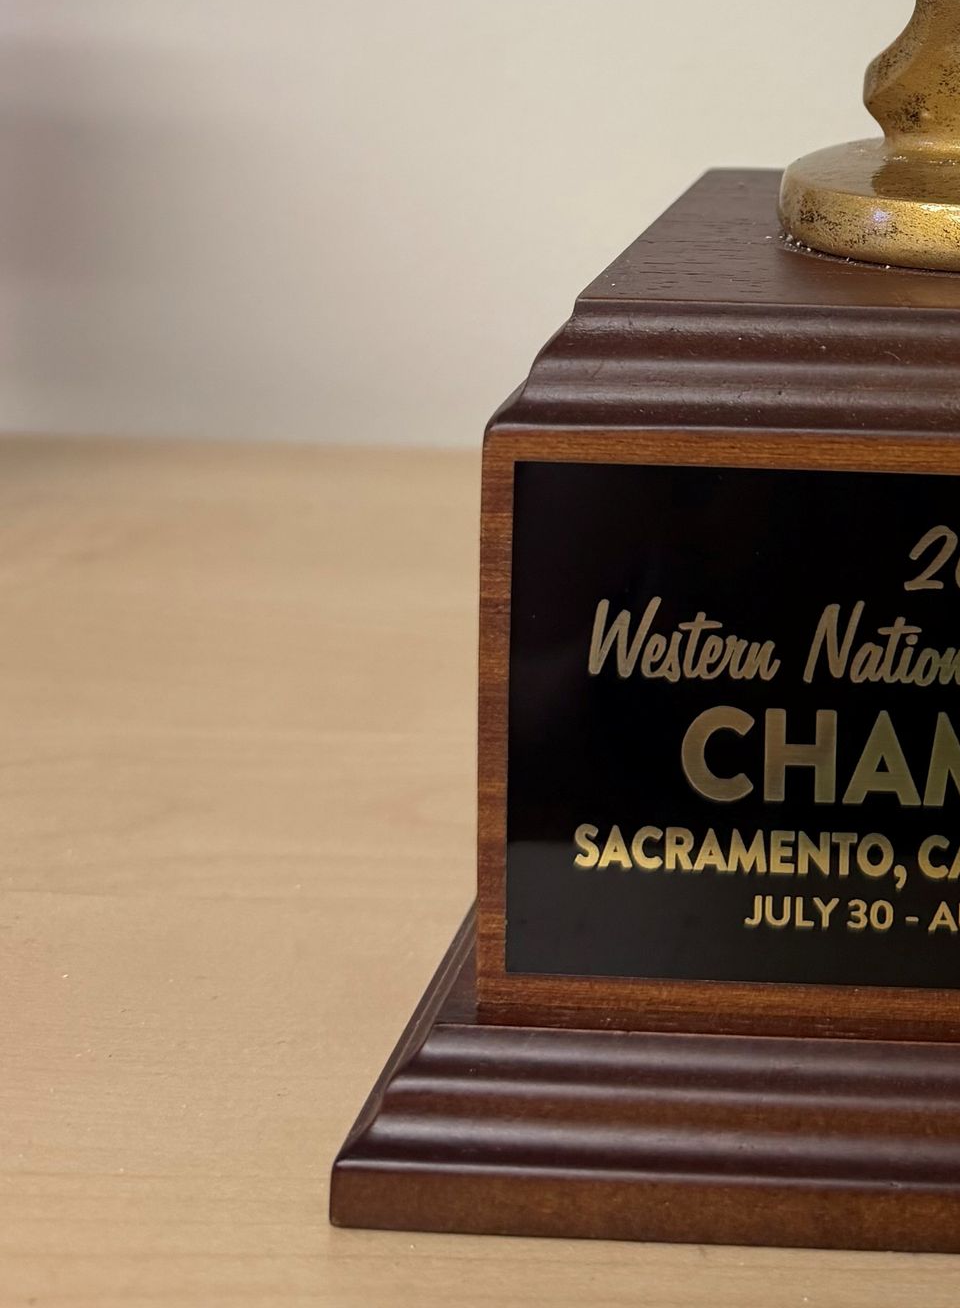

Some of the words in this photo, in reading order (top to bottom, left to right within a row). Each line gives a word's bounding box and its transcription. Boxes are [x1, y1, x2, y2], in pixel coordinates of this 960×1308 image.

[588, 596, 781, 682] Western
[574, 824, 908, 890] SACRAMENTO,
[744, 895, 840, 931] JULY
[847, 898, 894, 932] 30
